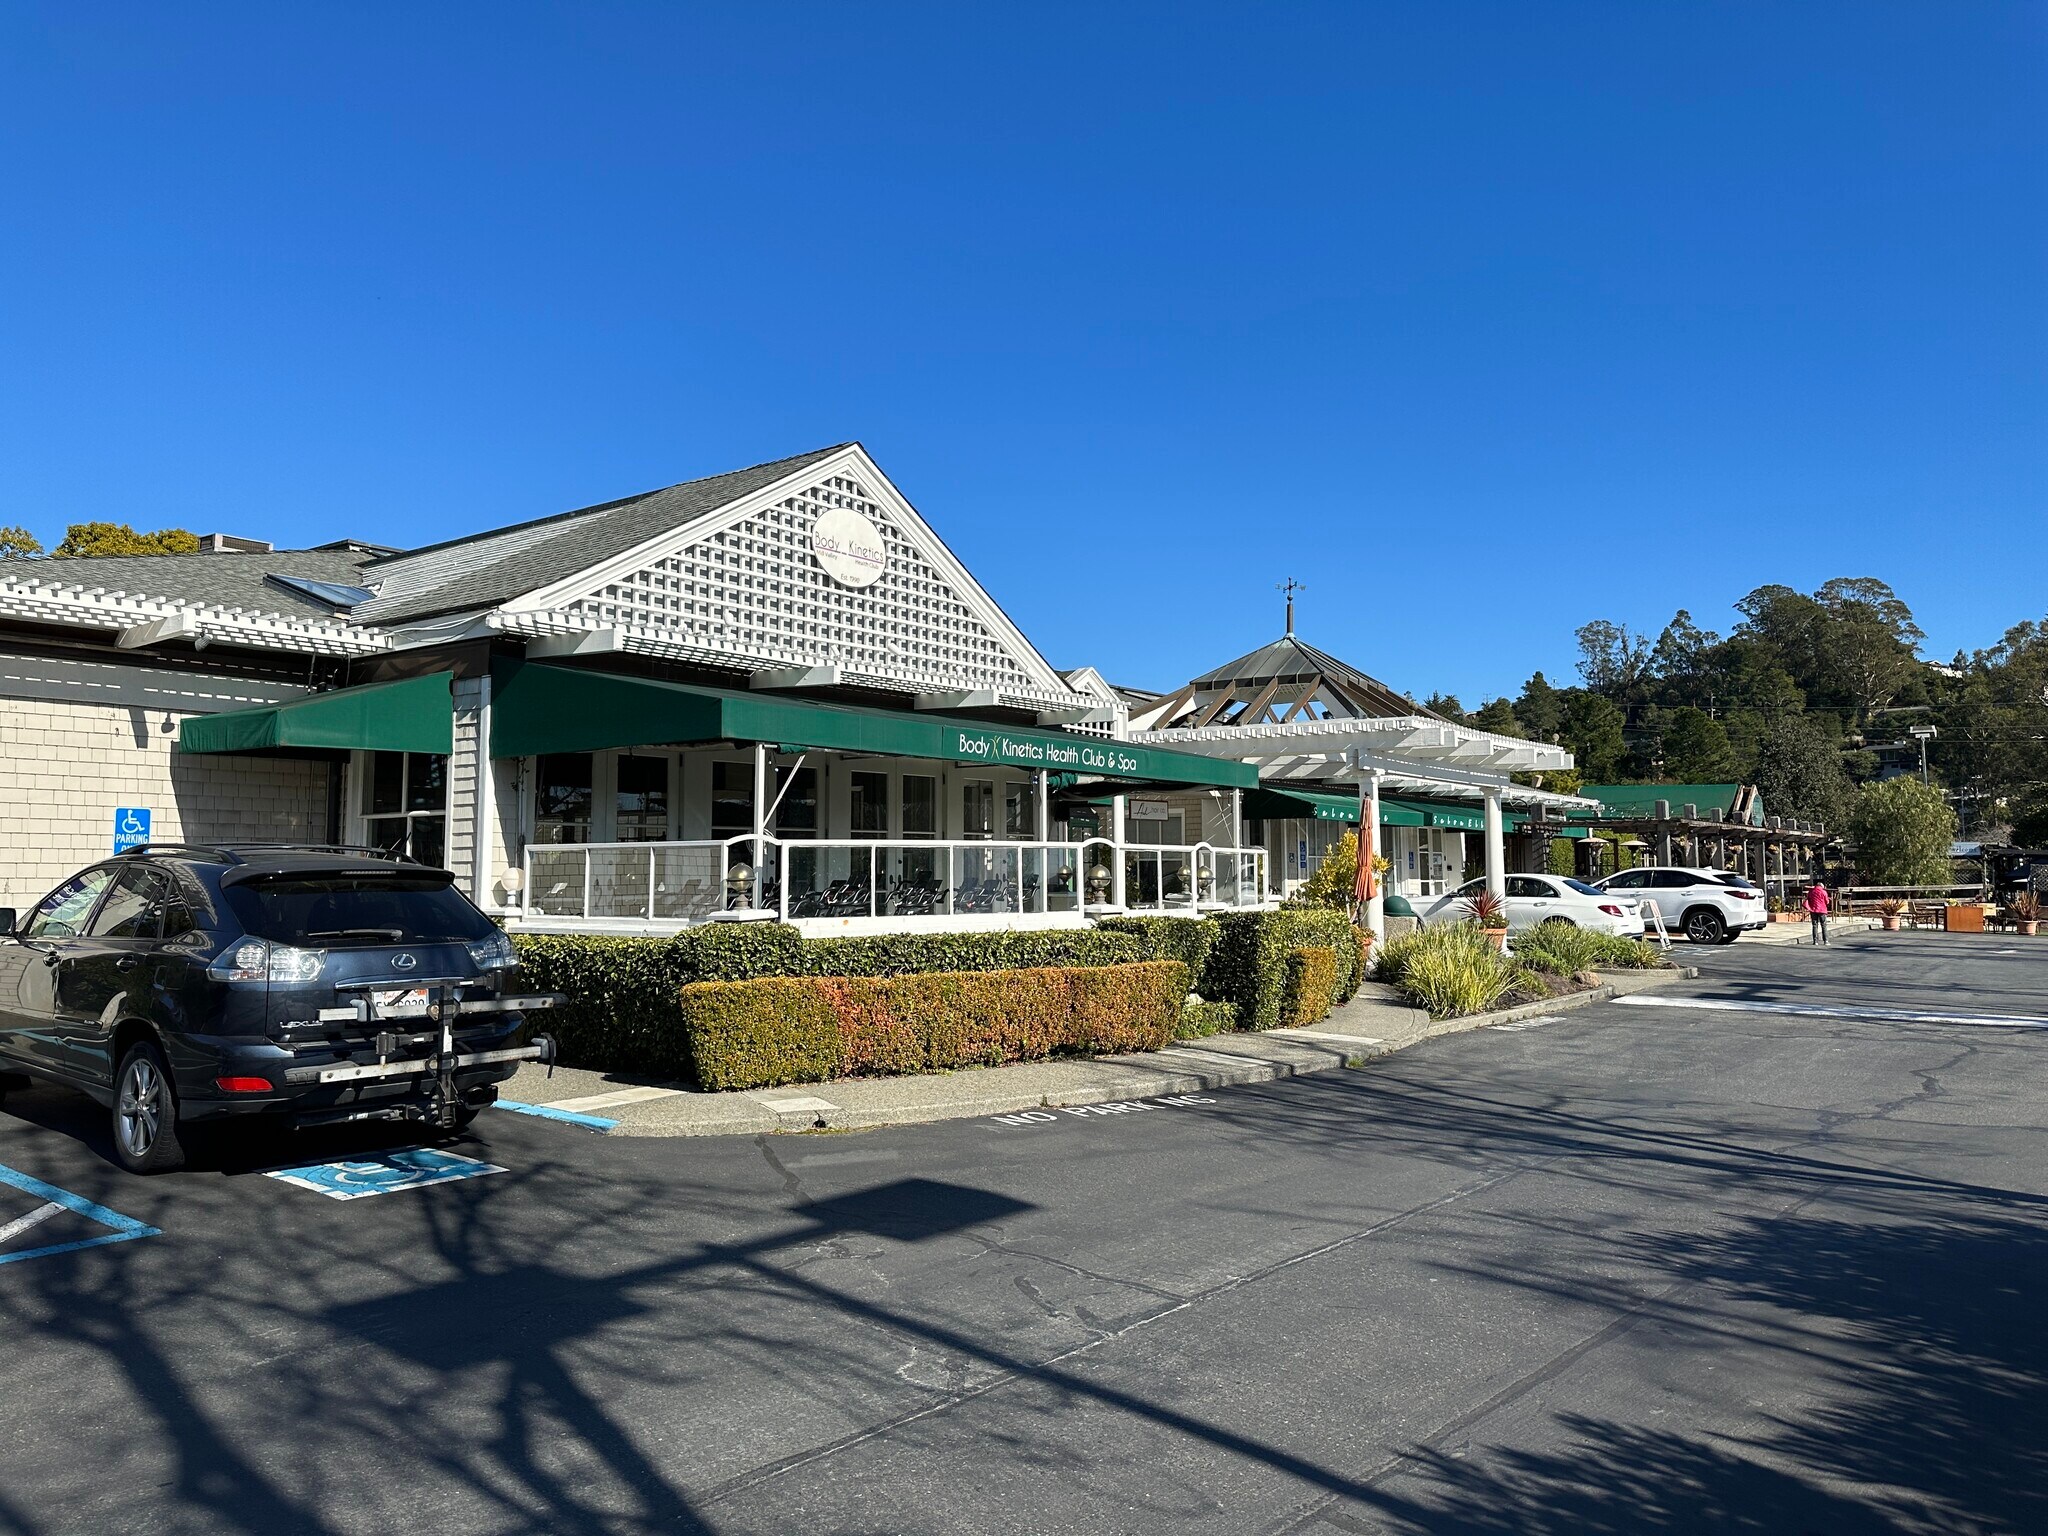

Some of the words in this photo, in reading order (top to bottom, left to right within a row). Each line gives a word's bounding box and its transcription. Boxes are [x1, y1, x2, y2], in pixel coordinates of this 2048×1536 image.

[815, 531, 840, 551] Body
[848, 540, 884, 562] Kinetics
[959, 733, 990, 758] Body
[1002, 738, 1043, 761] Kinetics
[1046, 743, 1079, 764] Health
[1082, 748, 1105, 768] Club
[1108, 751, 1115, 769] &
[1118, 753, 1137, 773] Spa
[116, 833, 149, 844] PARKING
[1468, 818, 1485, 829] Ell
[990, 1111, 1058, 1126] NO
[1060, 1095, 1217, 1118] PARKNG
